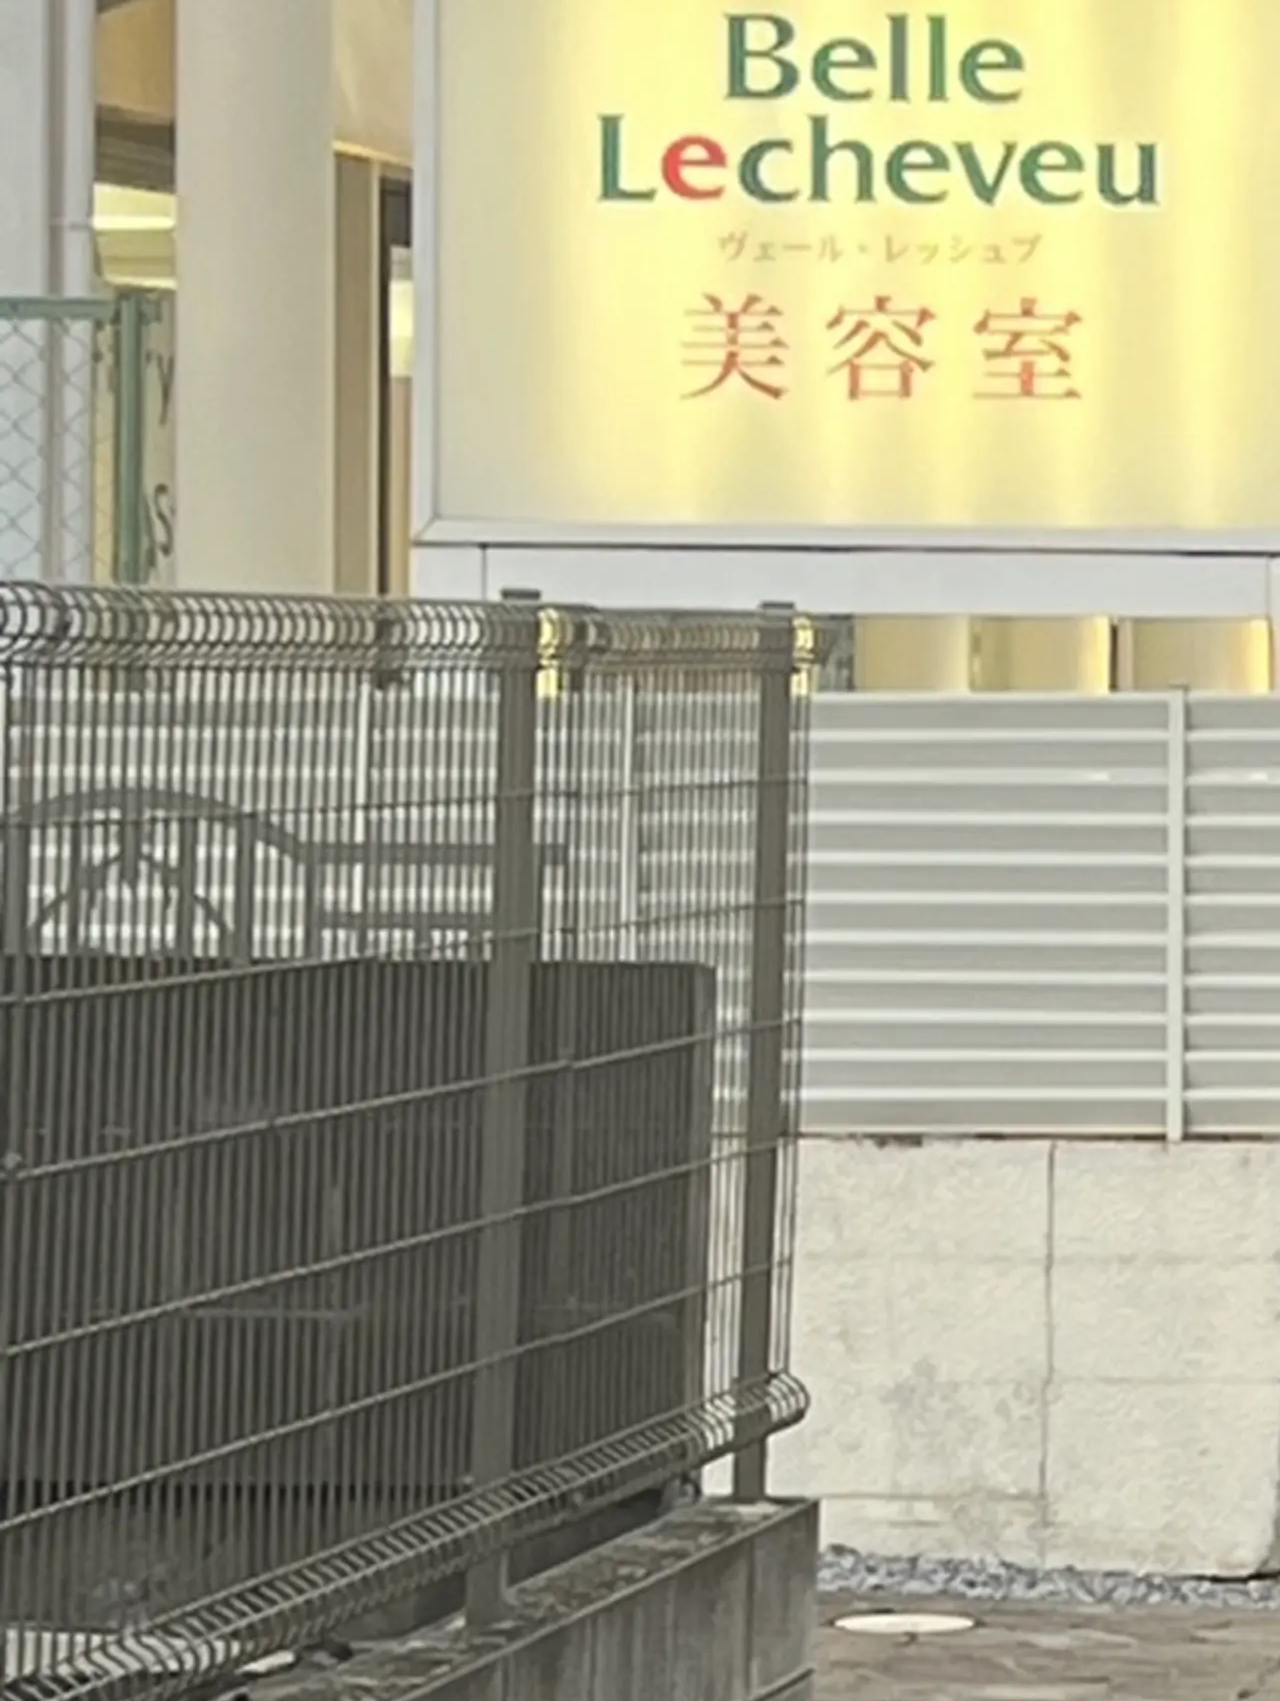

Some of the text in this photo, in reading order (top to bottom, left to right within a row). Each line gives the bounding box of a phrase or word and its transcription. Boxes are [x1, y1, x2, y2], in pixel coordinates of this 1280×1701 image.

[724, 11, 1026, 103] Belle
[596, 114, 1160, 207] Lecheveu
[679, 292, 1084, 401] 美容室
